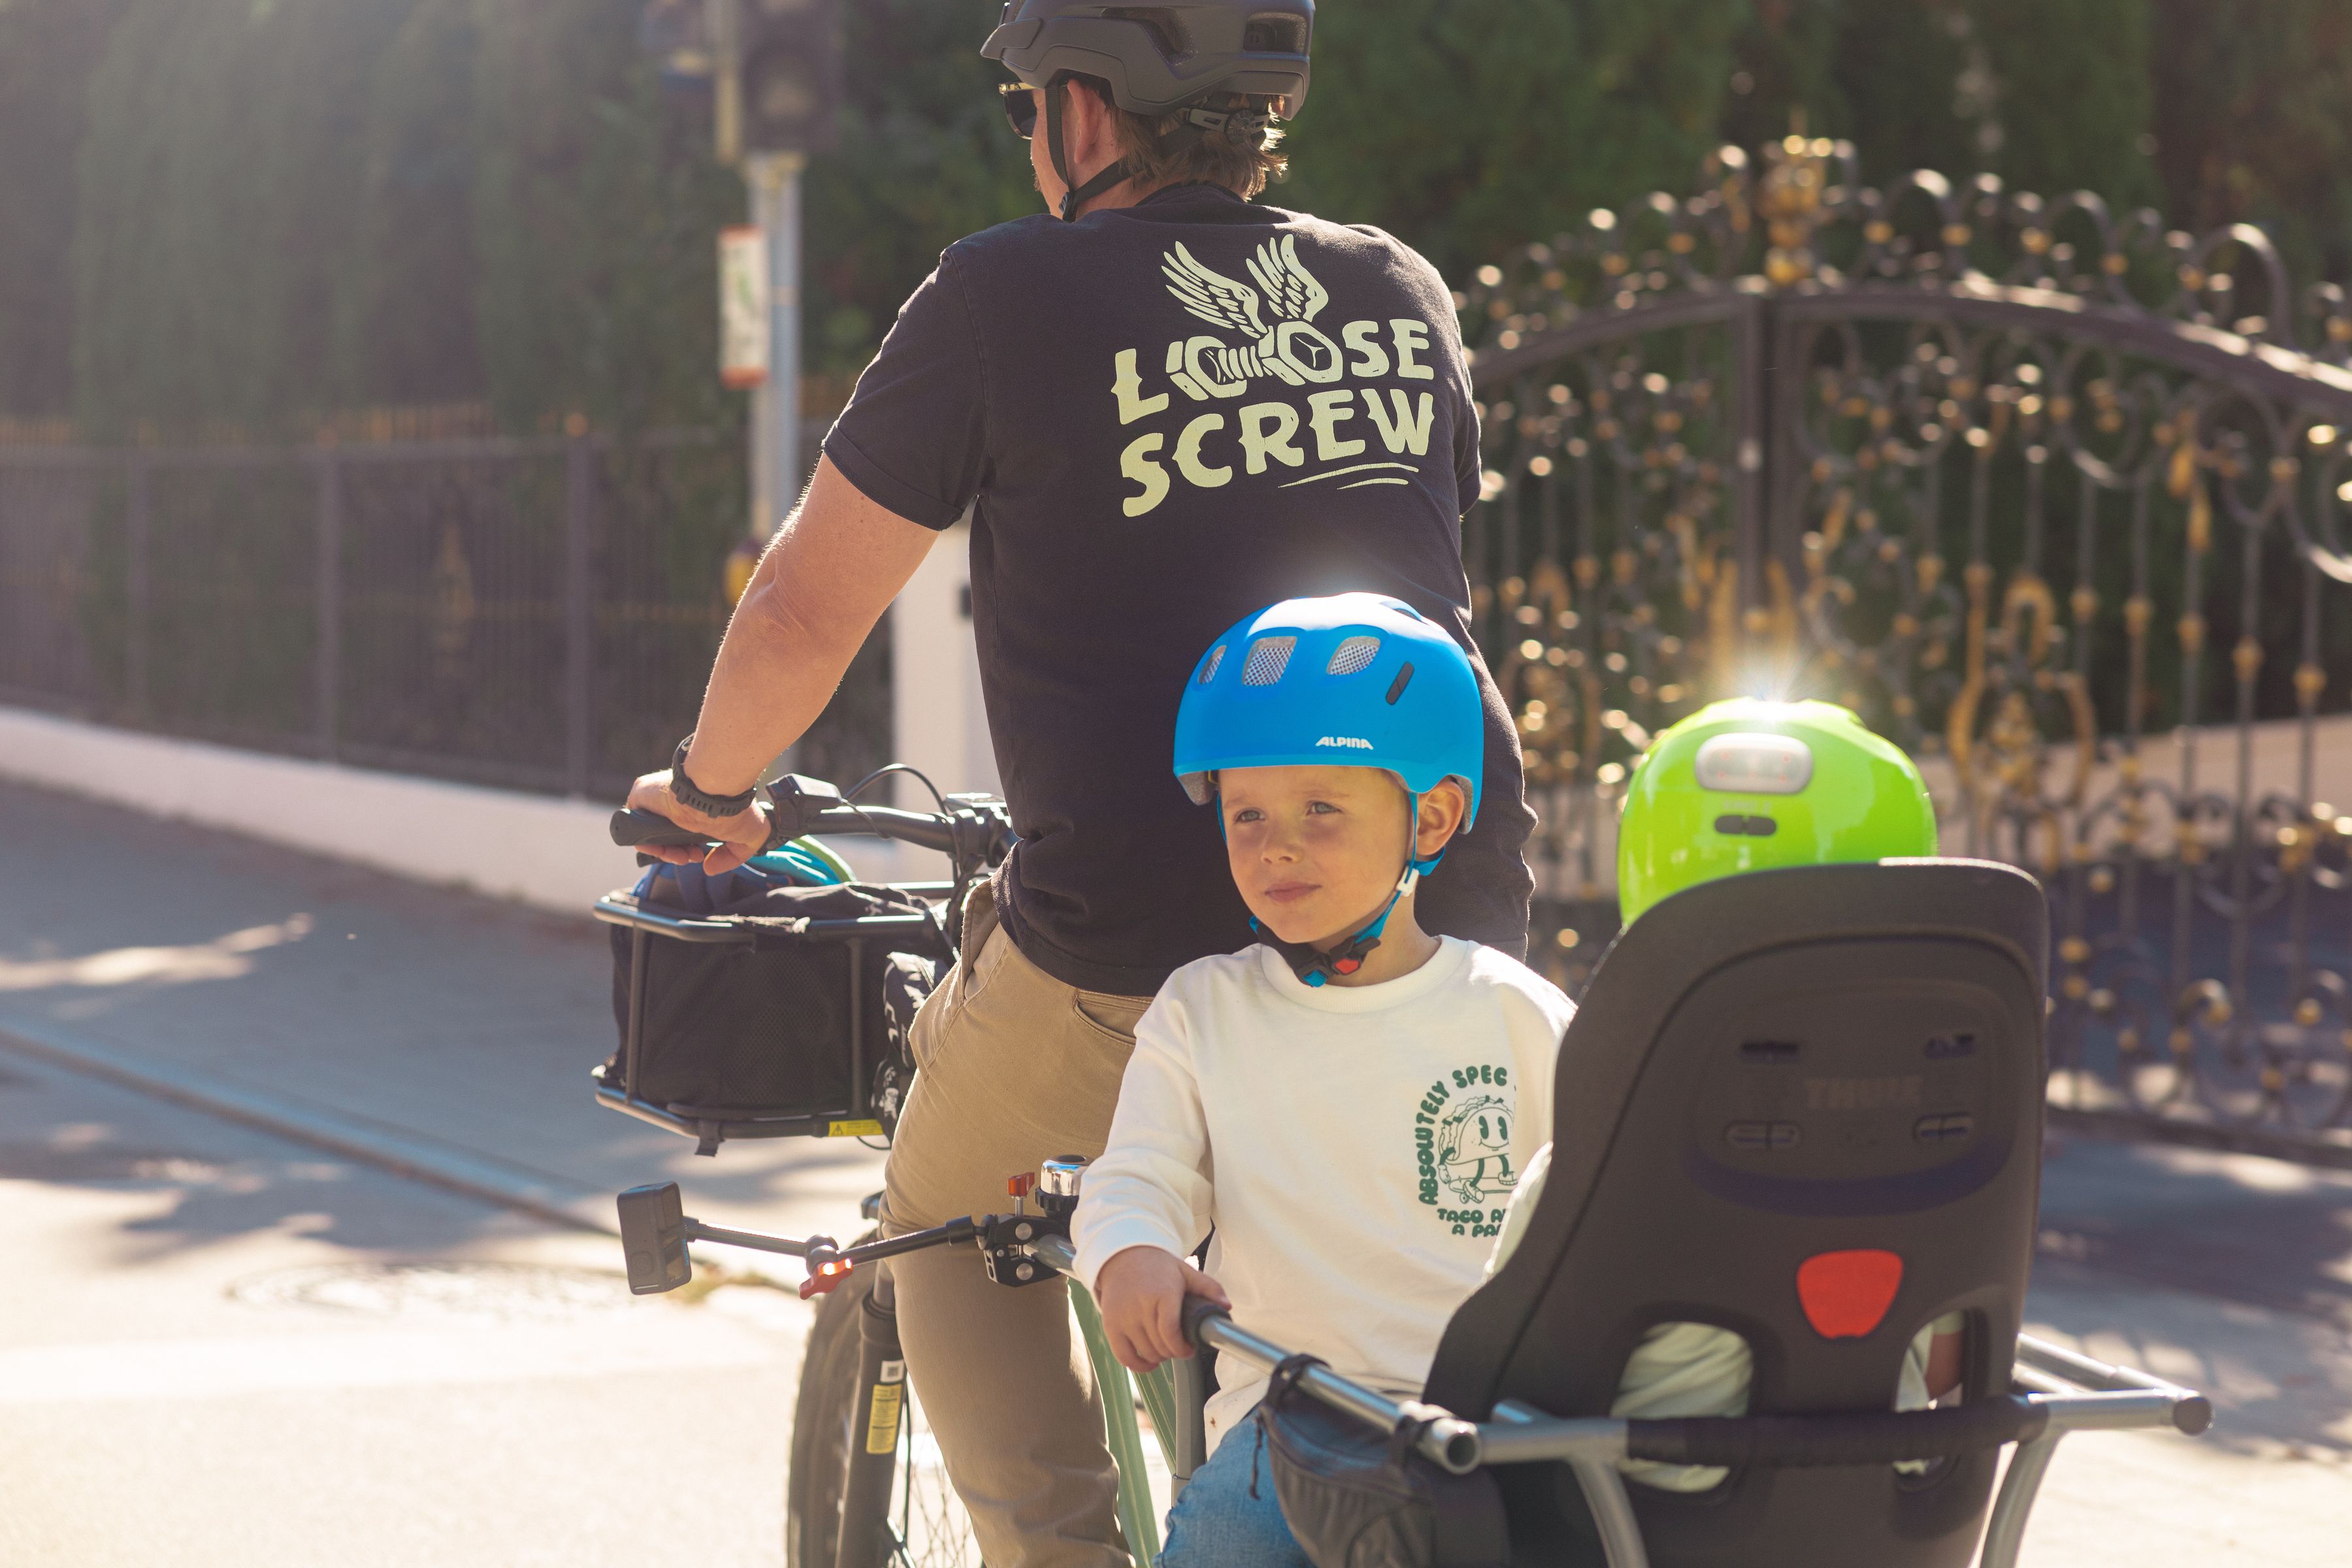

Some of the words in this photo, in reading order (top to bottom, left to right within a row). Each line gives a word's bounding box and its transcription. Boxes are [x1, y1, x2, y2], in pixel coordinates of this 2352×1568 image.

[1111, 318, 1434, 425] LOOSE
[1120, 388, 1435, 517] SCREW
[1316, 736, 1373, 750] ALPINA
[1415, 1081, 1450, 1205] ABSOLUTELY
[1452, 1064, 1507, 1088] SPEC
[1437, 1209, 1484, 1223] TACO
[1491, 1209, 1507, 1223] A
[1452, 1224, 1465, 1235] A
